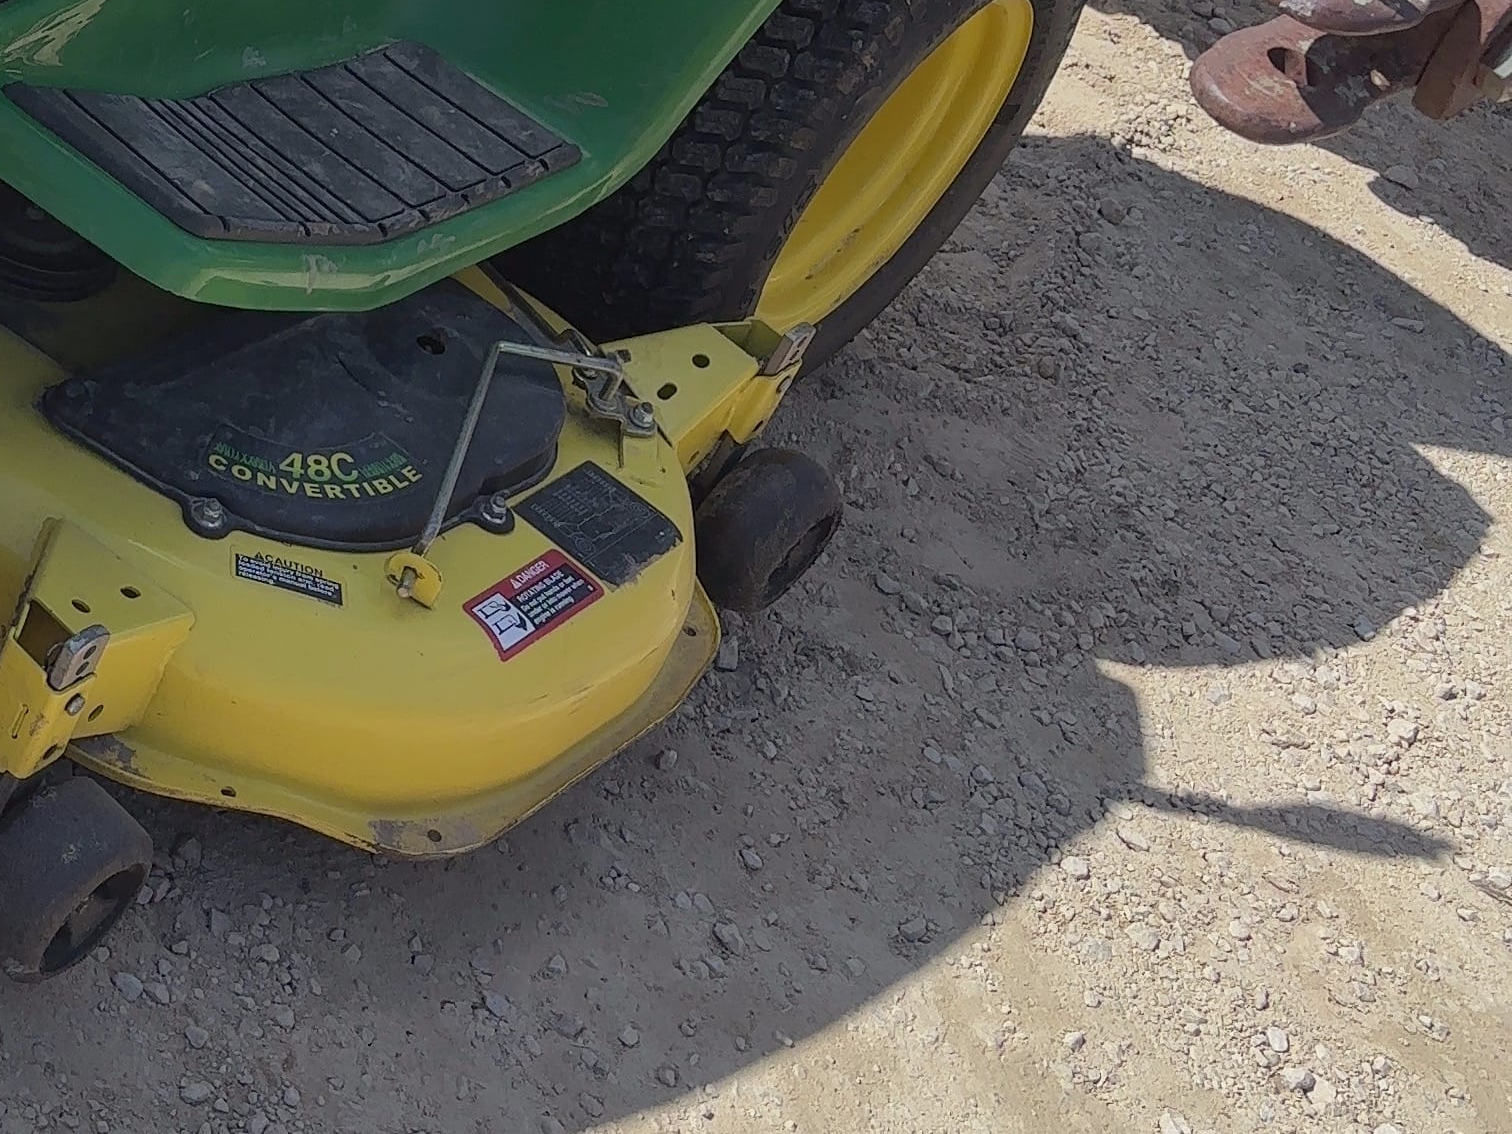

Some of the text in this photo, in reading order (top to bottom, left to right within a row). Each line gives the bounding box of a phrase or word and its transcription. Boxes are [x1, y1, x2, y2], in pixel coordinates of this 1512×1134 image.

[208, 453, 423, 500] CONVERTIBLE
[279, 451, 359, 482] 48C
[264, 555, 324, 578] CAUTION
[517, 559, 550, 583] DANGER
